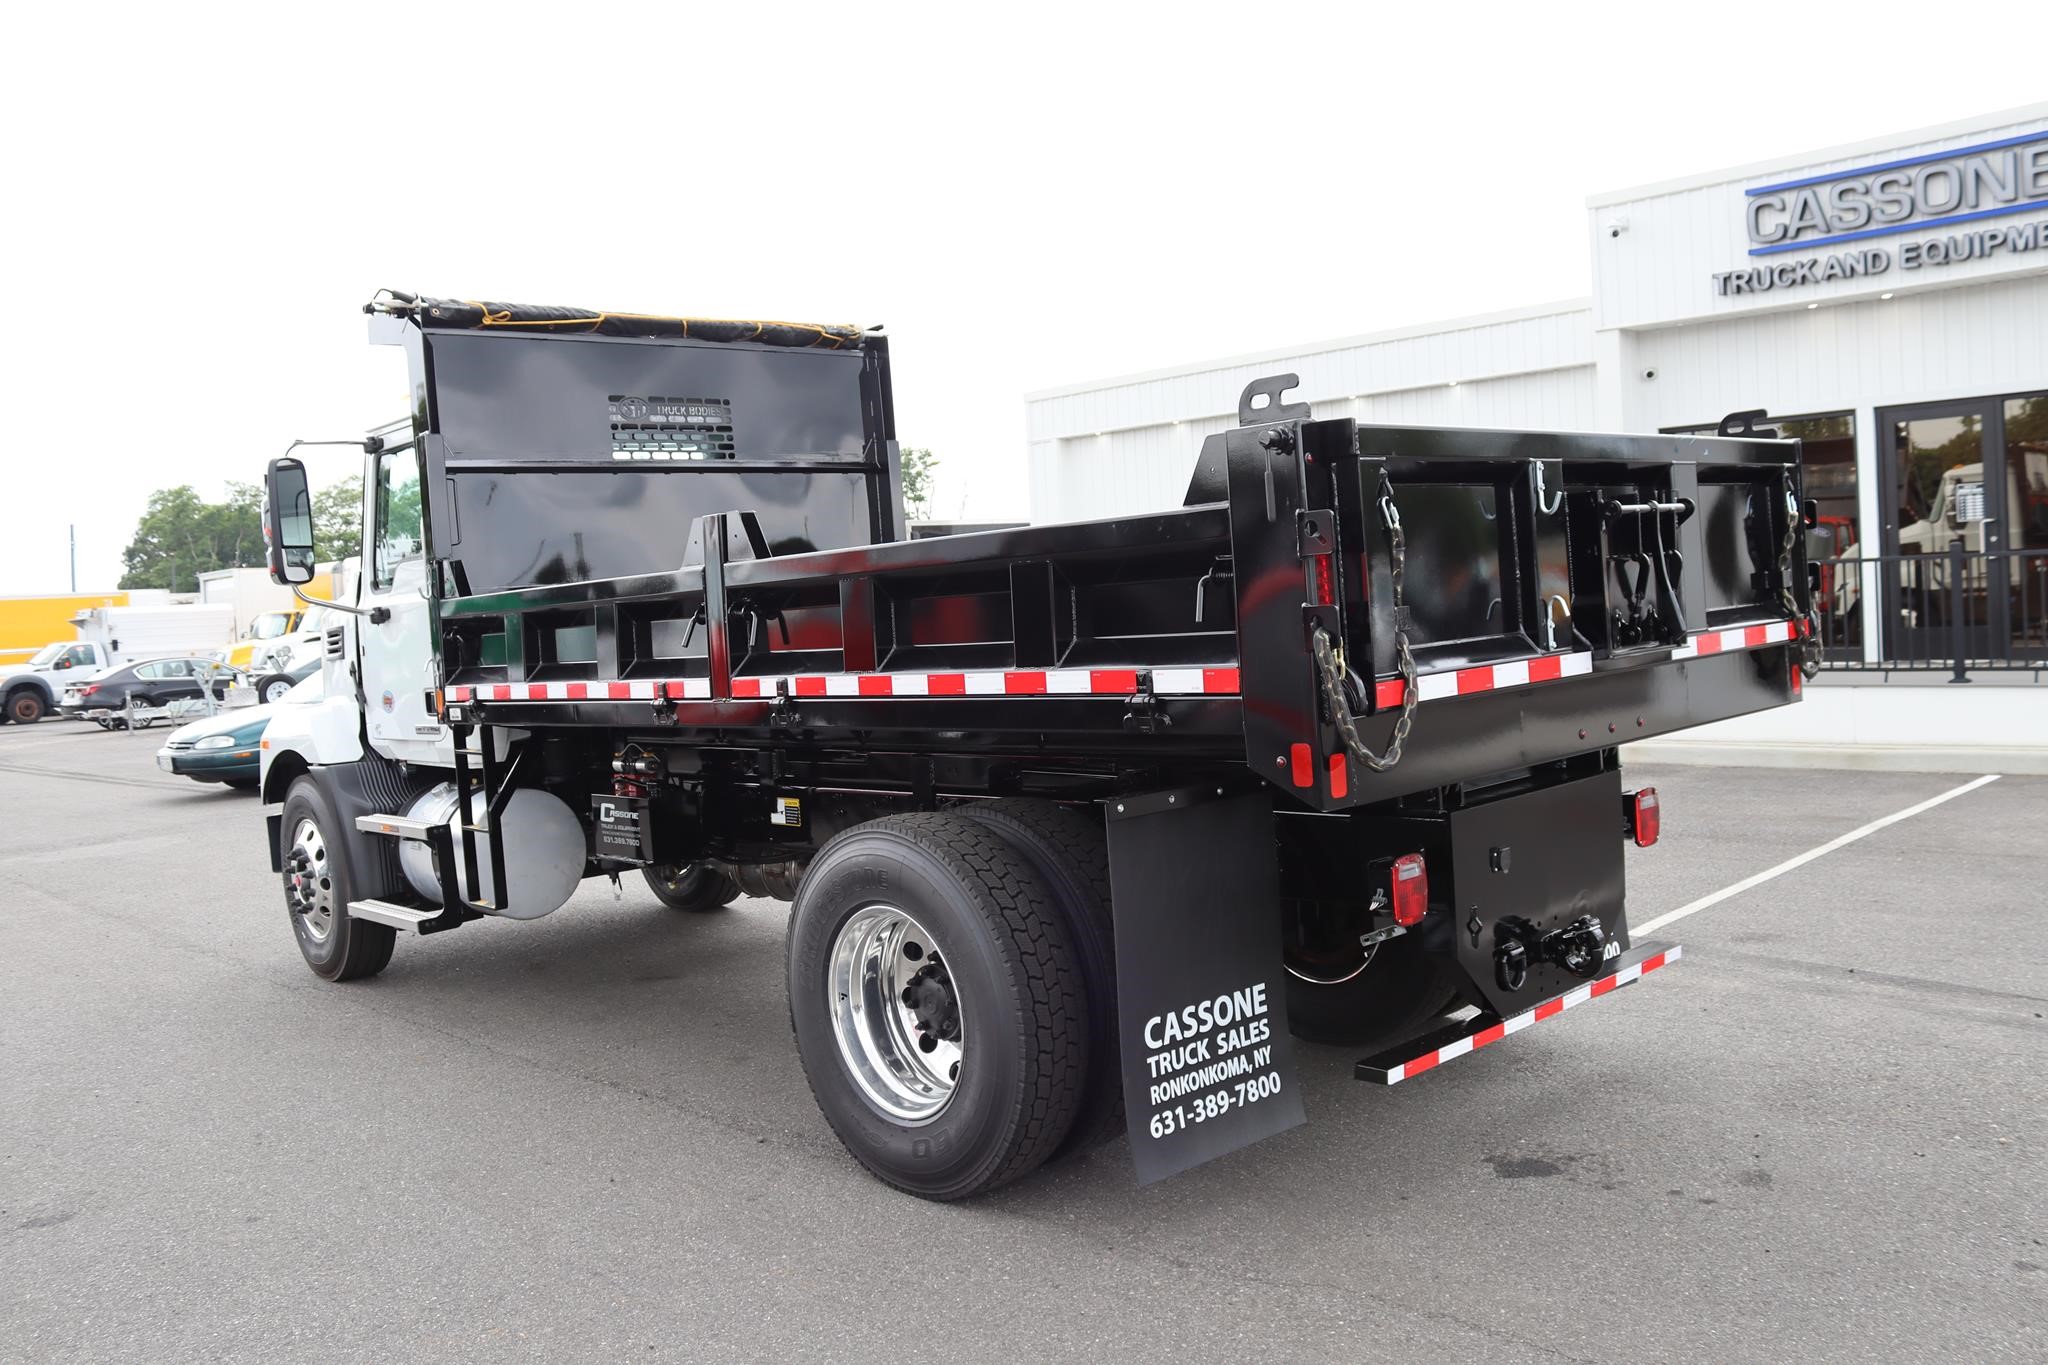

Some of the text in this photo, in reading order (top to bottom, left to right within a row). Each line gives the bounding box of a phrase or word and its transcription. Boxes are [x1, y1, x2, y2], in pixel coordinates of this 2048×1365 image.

[1746, 142, 2048, 244] CASSONE
[1712, 258, 1821, 296] TRUCK
[1821, 248, 1890, 281] AND
[655, 405, 687, 416] TRUCK
[688, 405, 722, 417] BODIES
[1144, 982, 1268, 1050] CASSONE
[1147, 1018, 1270, 1078] TRUCK SALES
[1150, 1045, 1272, 1106] RONKONKOMA, NY
[1149, 1071, 1281, 1139] 631-389-7800
